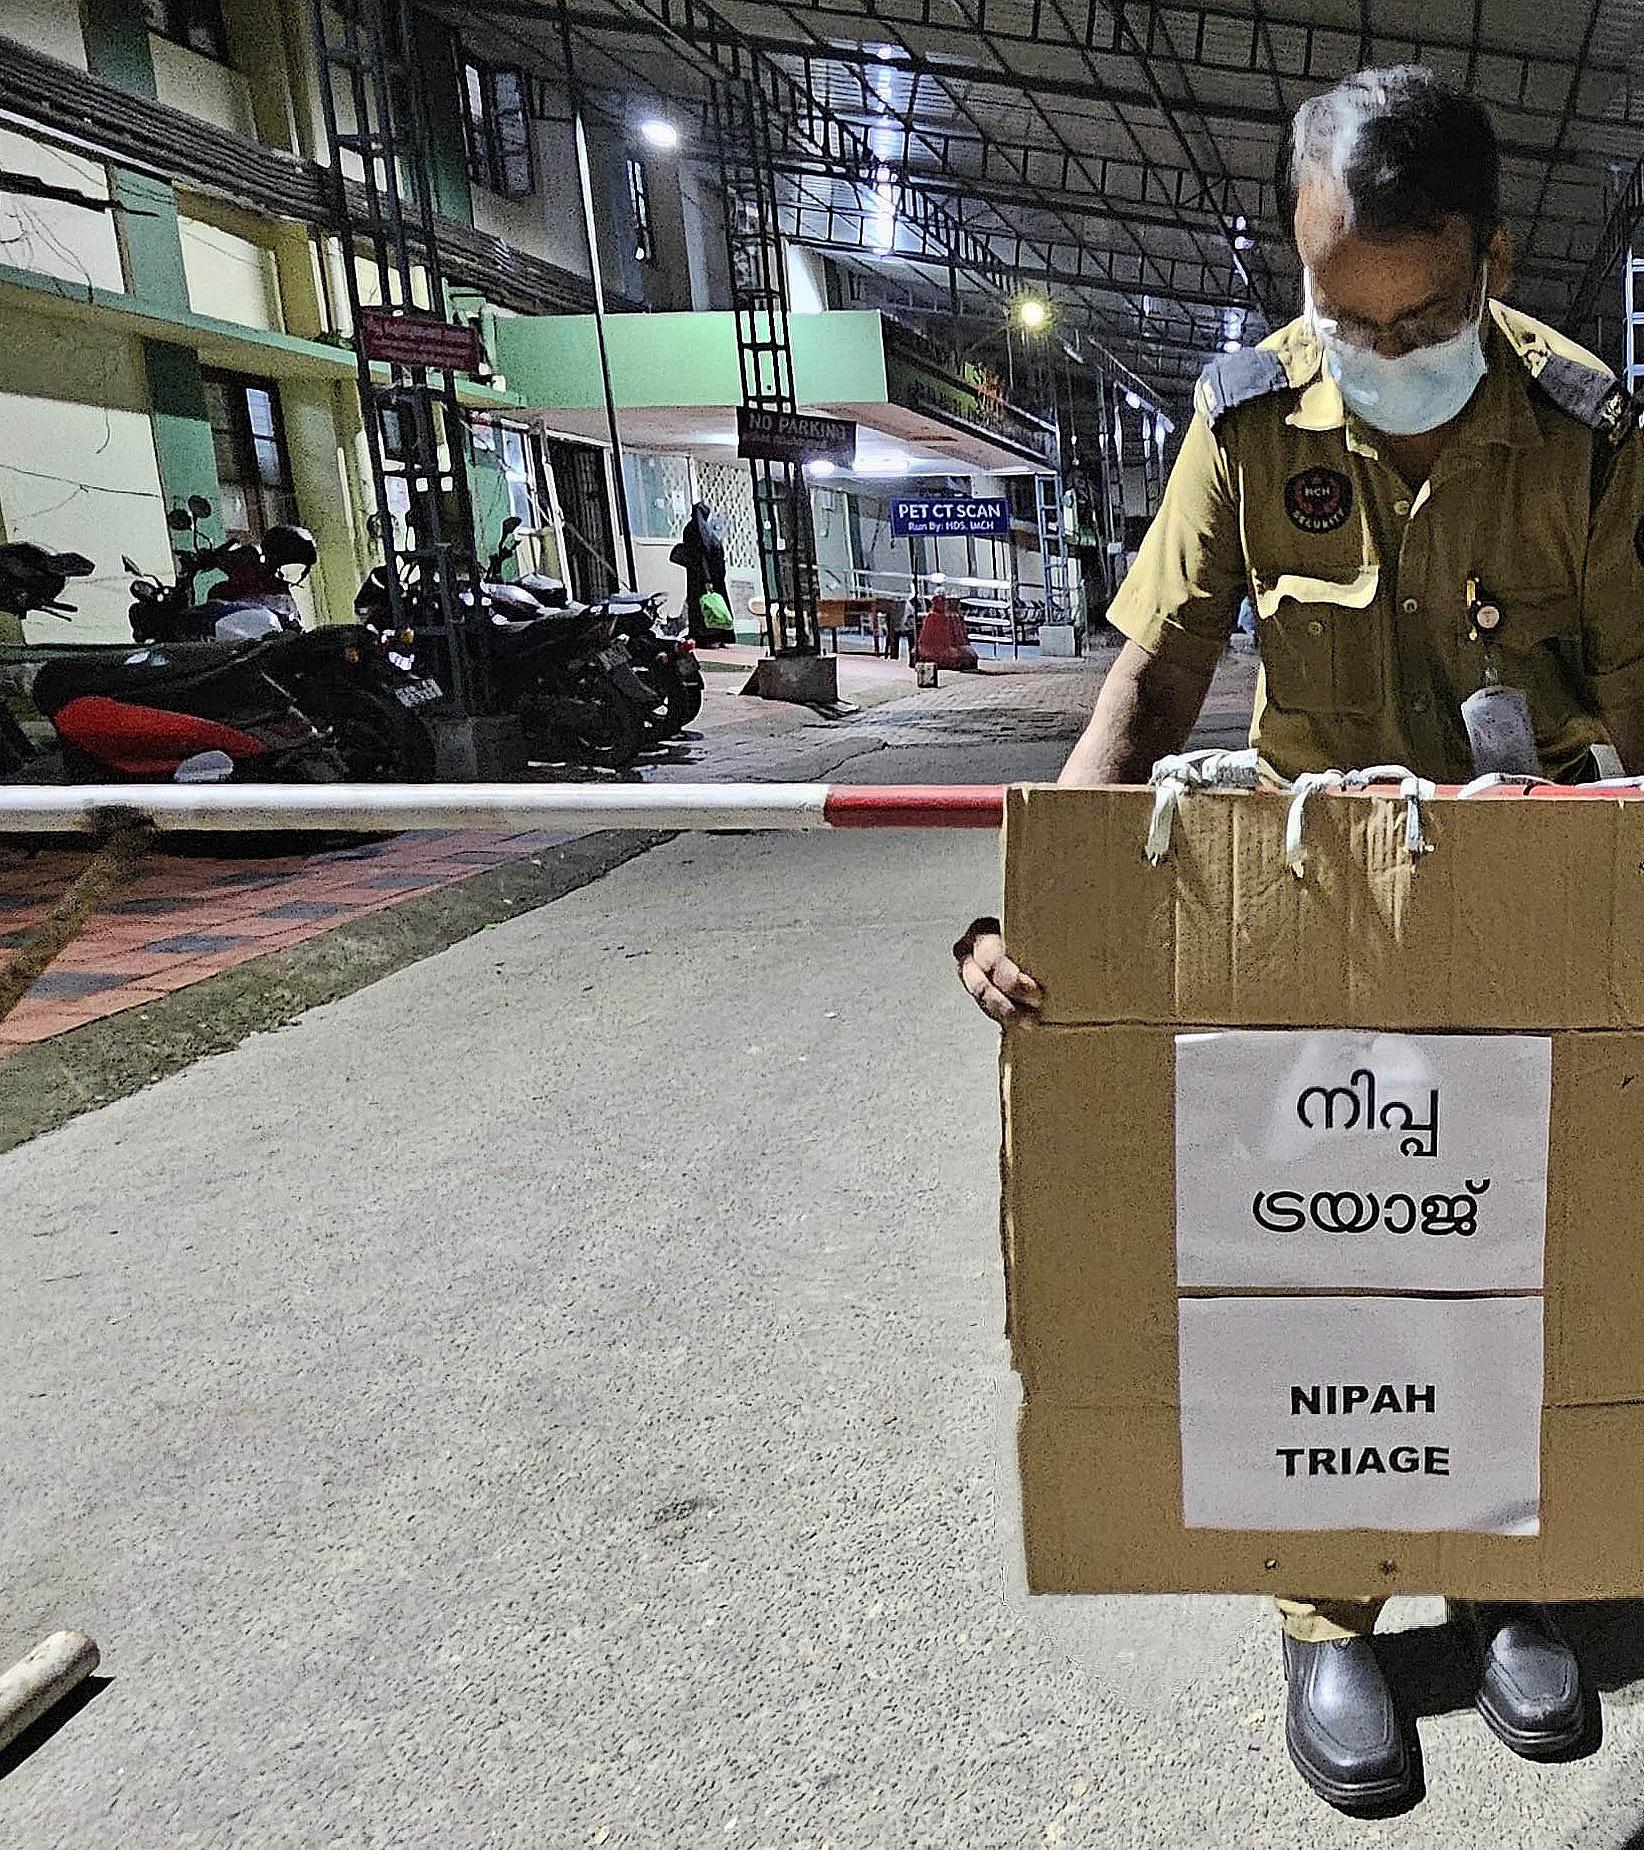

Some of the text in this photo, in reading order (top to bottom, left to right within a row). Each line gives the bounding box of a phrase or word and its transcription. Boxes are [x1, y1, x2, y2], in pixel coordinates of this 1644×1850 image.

[749, 412, 773, 432] NO
[898, 503, 1001, 519] PET CT SCAN
[1296, 1067, 1439, 1159] നിപ്പ
[1252, 1177, 1491, 1237] ട്രയാജ്
[1290, 1384, 1437, 1416] NIPAH
[1275, 1445, 1451, 1477] TRIAGE
